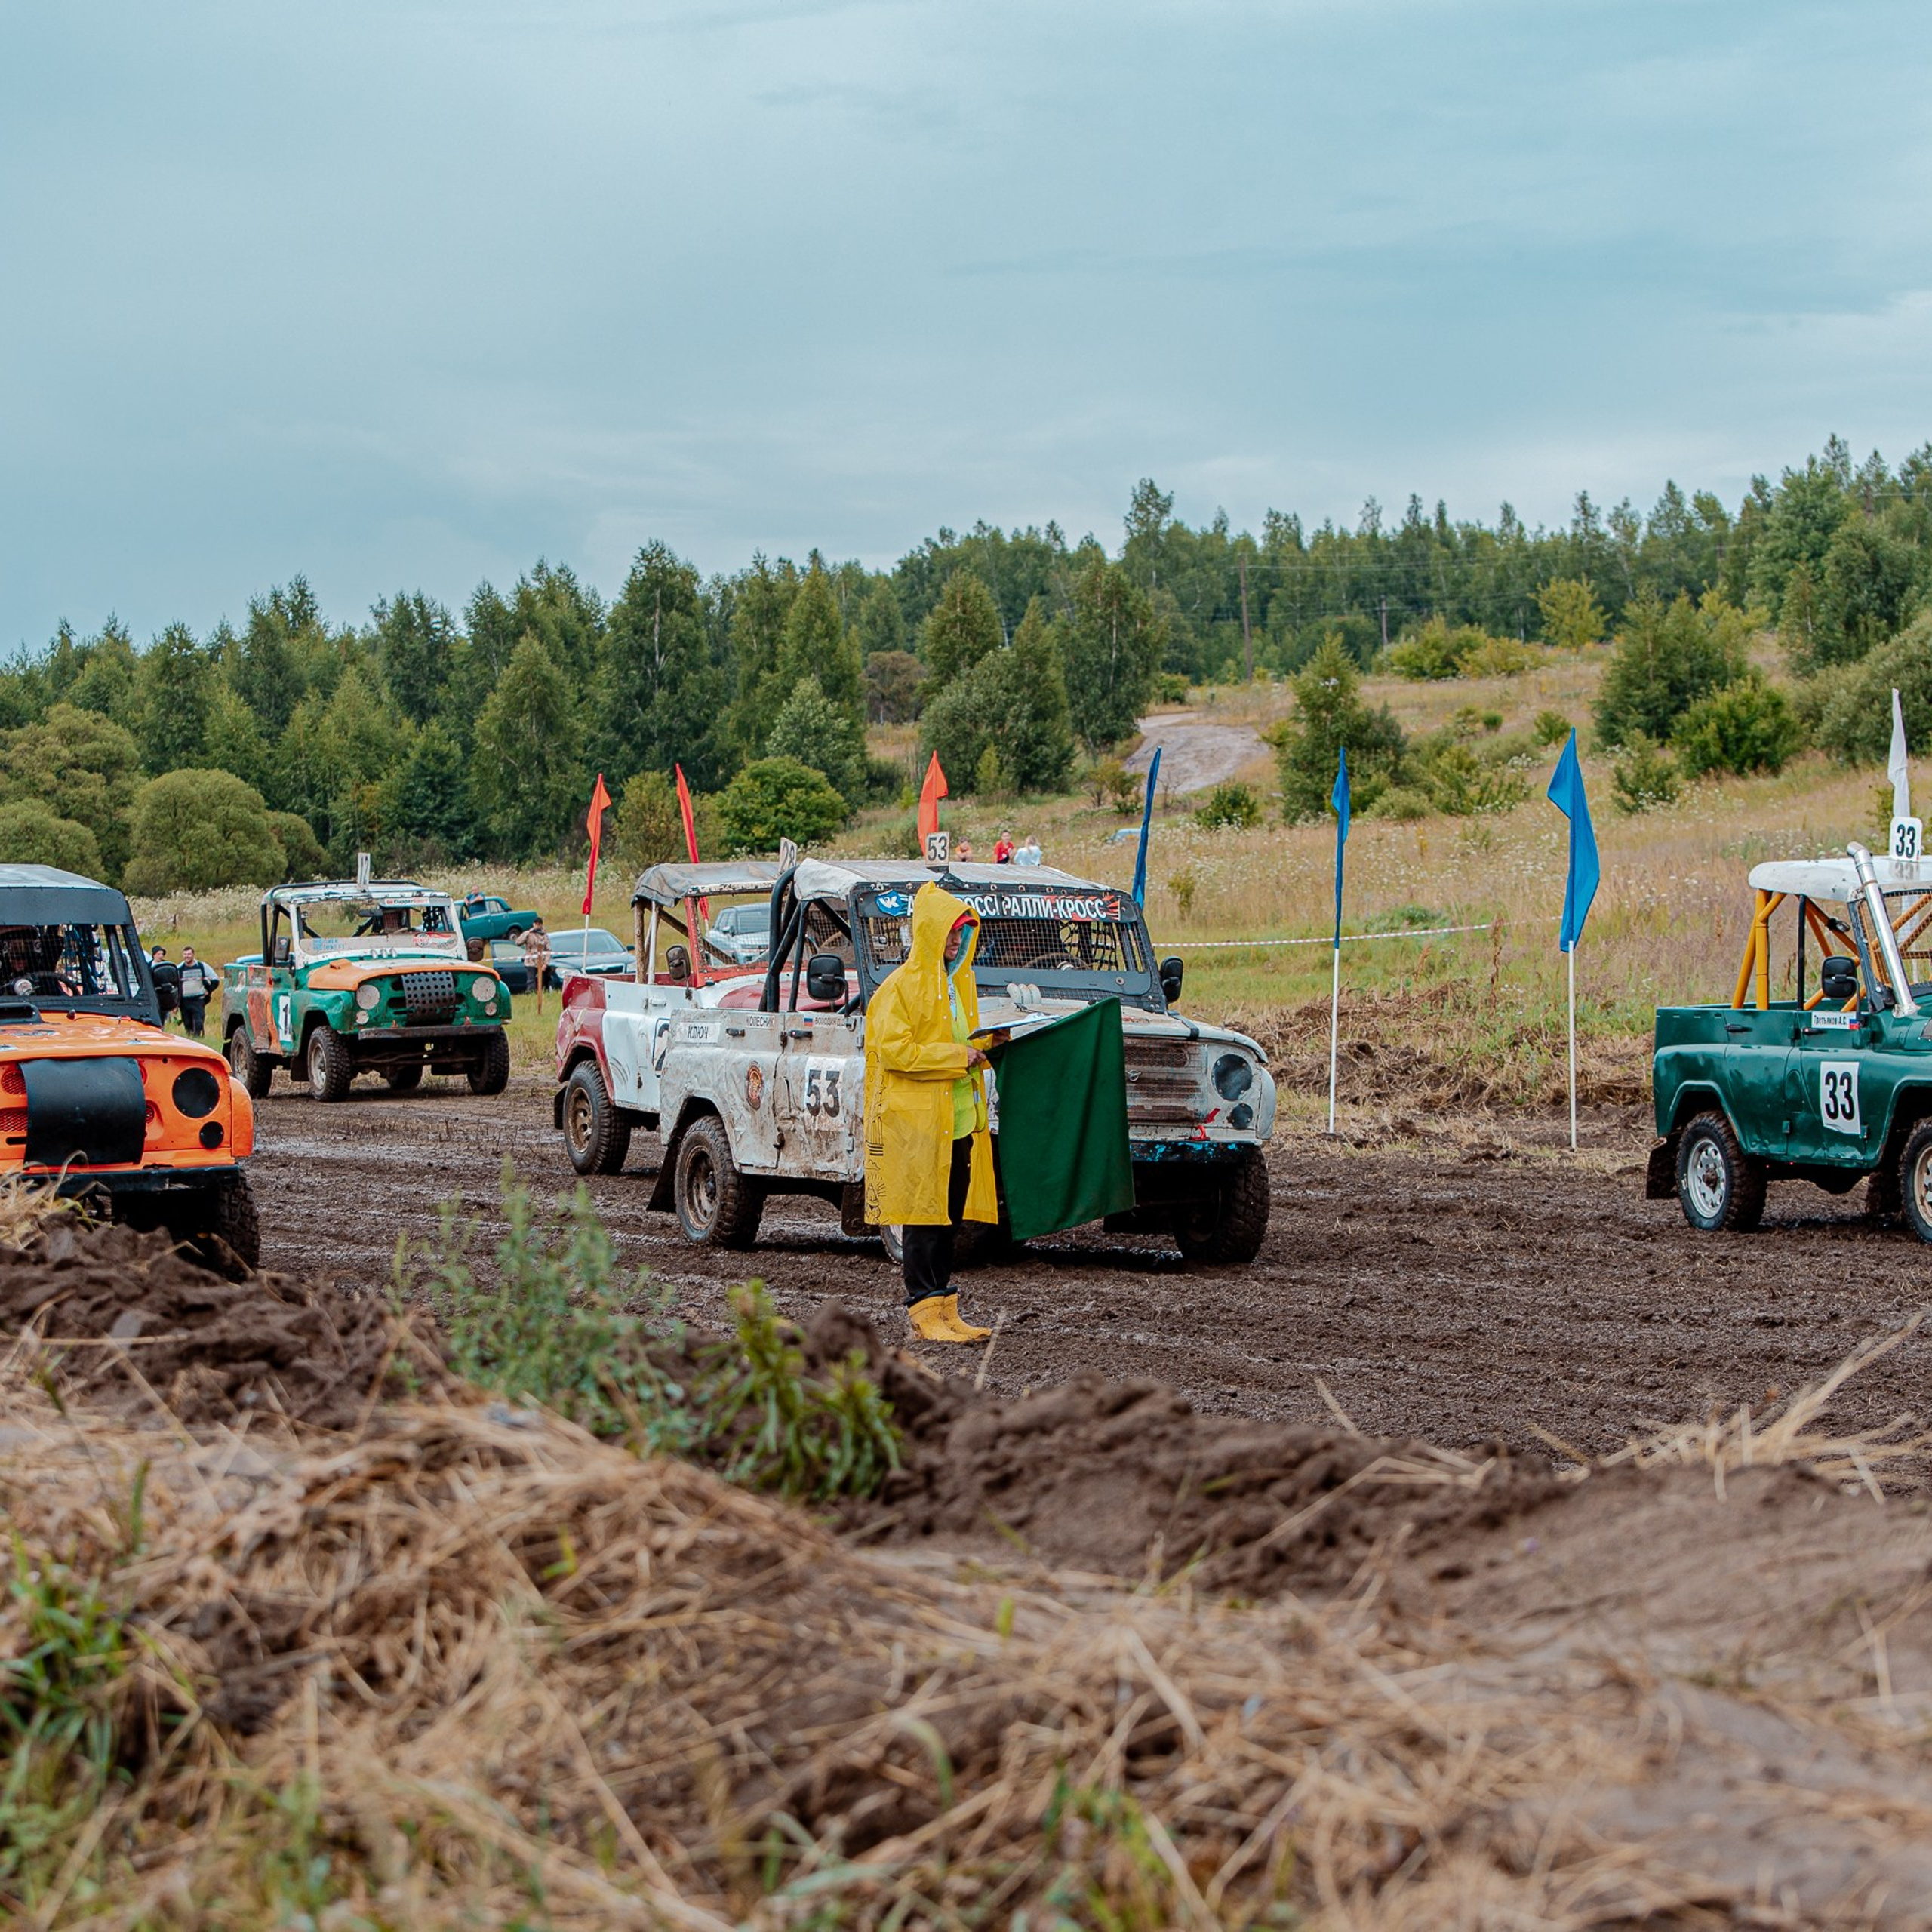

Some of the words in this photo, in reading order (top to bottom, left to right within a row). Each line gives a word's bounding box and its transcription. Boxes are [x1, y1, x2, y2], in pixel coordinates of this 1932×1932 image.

[928, 835, 947, 861] 53
[1895, 824, 1915, 859] 33
[1001, 896, 1107, 919] РАЛЛИ-КРОСС
[688, 1026, 709, 1039] КЛЮЧ
[805, 1069, 840, 1118] 53
[1825, 1070, 1855, 1121] 33
